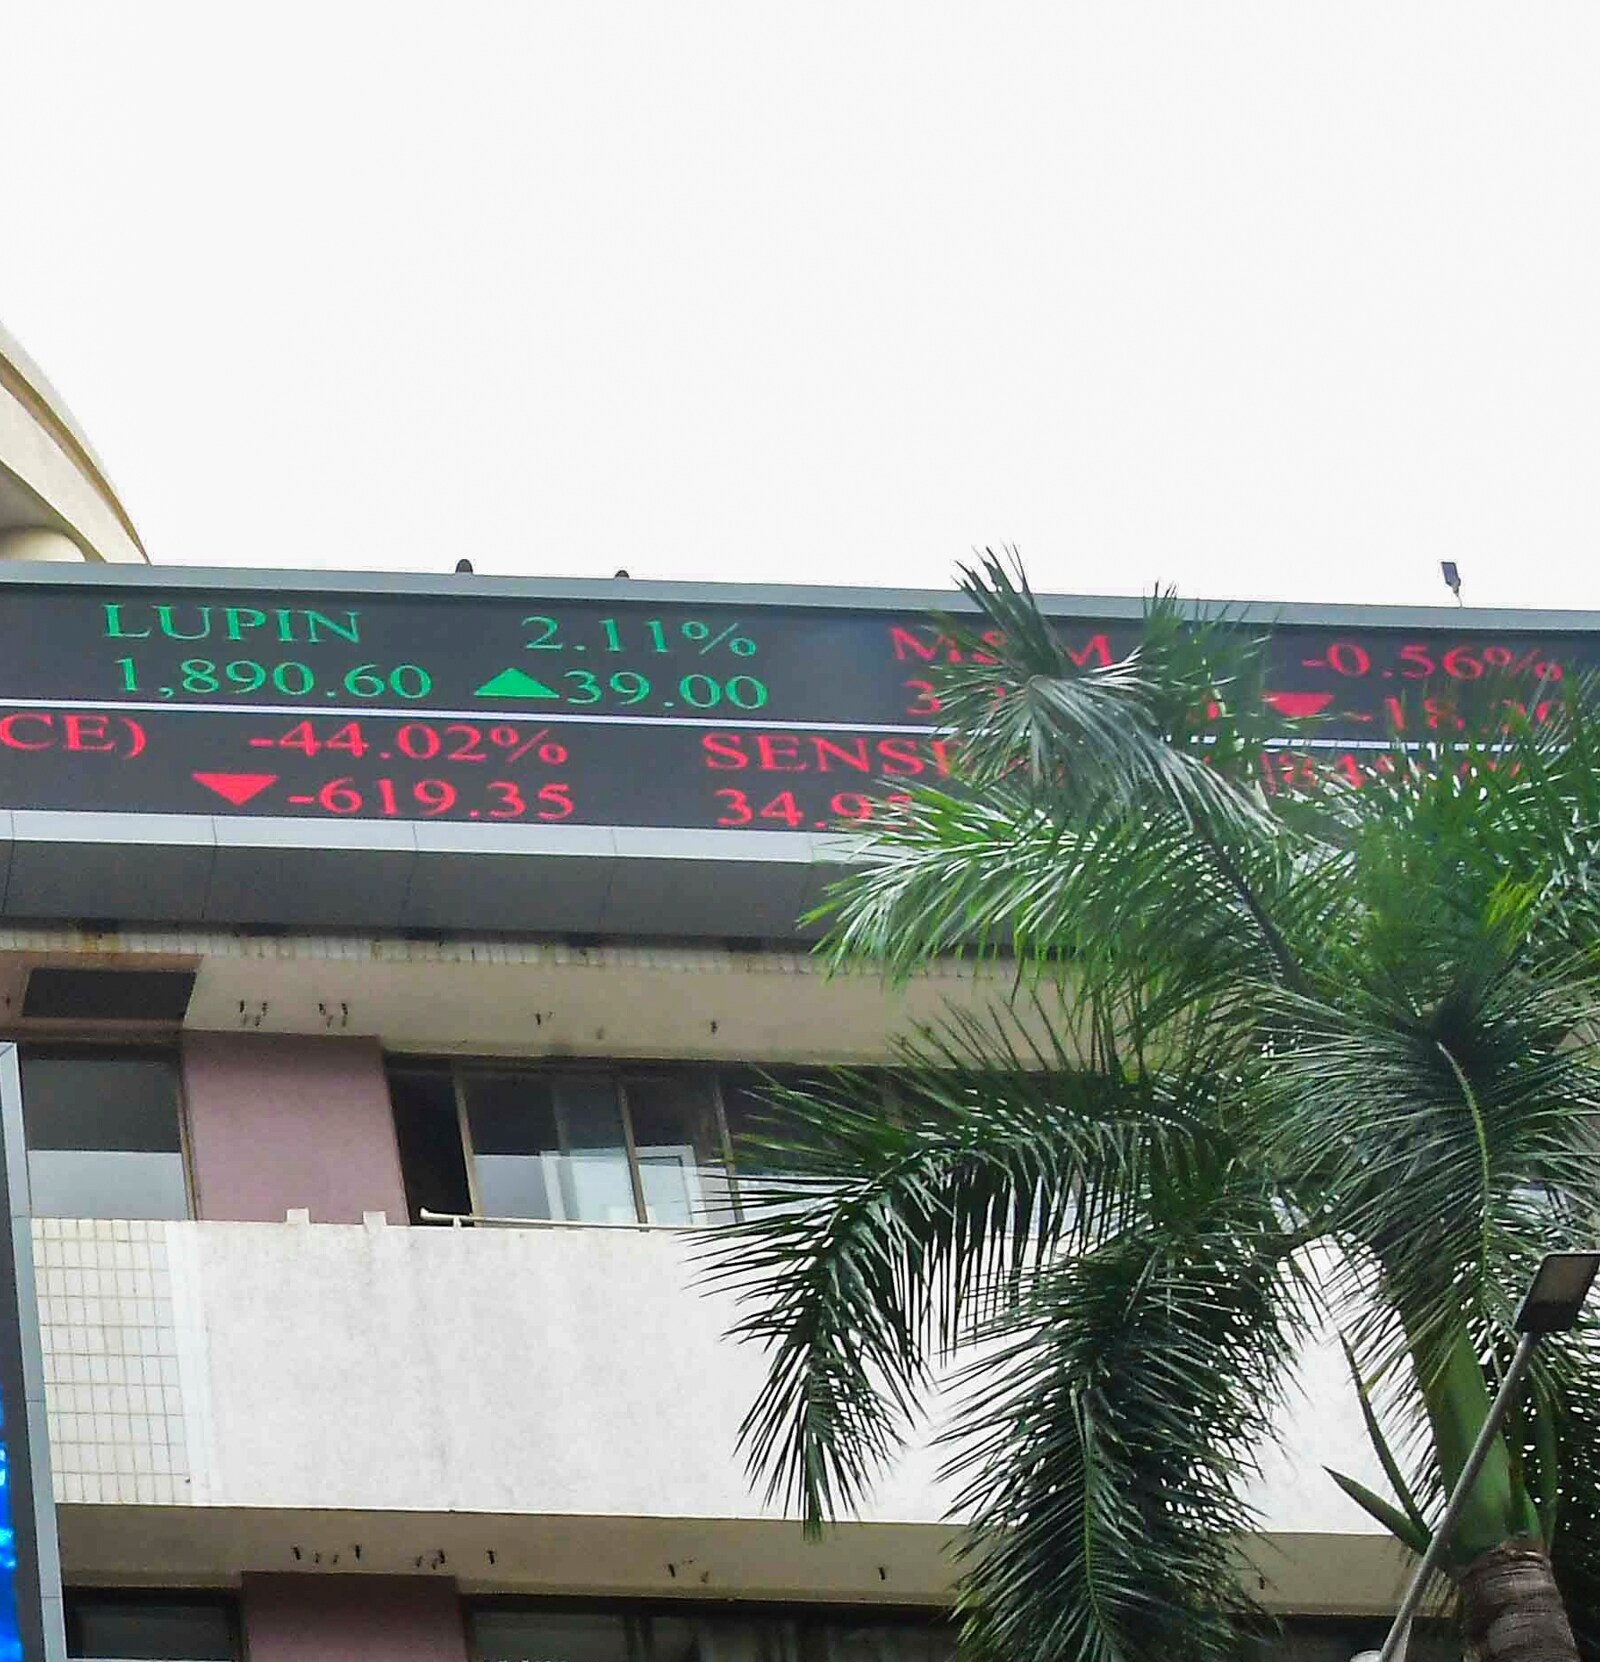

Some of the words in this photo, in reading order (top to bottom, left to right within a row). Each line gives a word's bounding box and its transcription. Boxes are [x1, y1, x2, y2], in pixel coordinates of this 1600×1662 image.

[102, 603, 362, 646] LUPIN
[524, 615, 758, 659] 2.11%
[114, 656, 433, 701] 1,890.60
[565, 669, 769, 711] 39.00
[1300, 641, 1565, 683] -0.56%
[249, 721, 569, 767] -44.02%
[287, 779, 576, 820] -619.35
